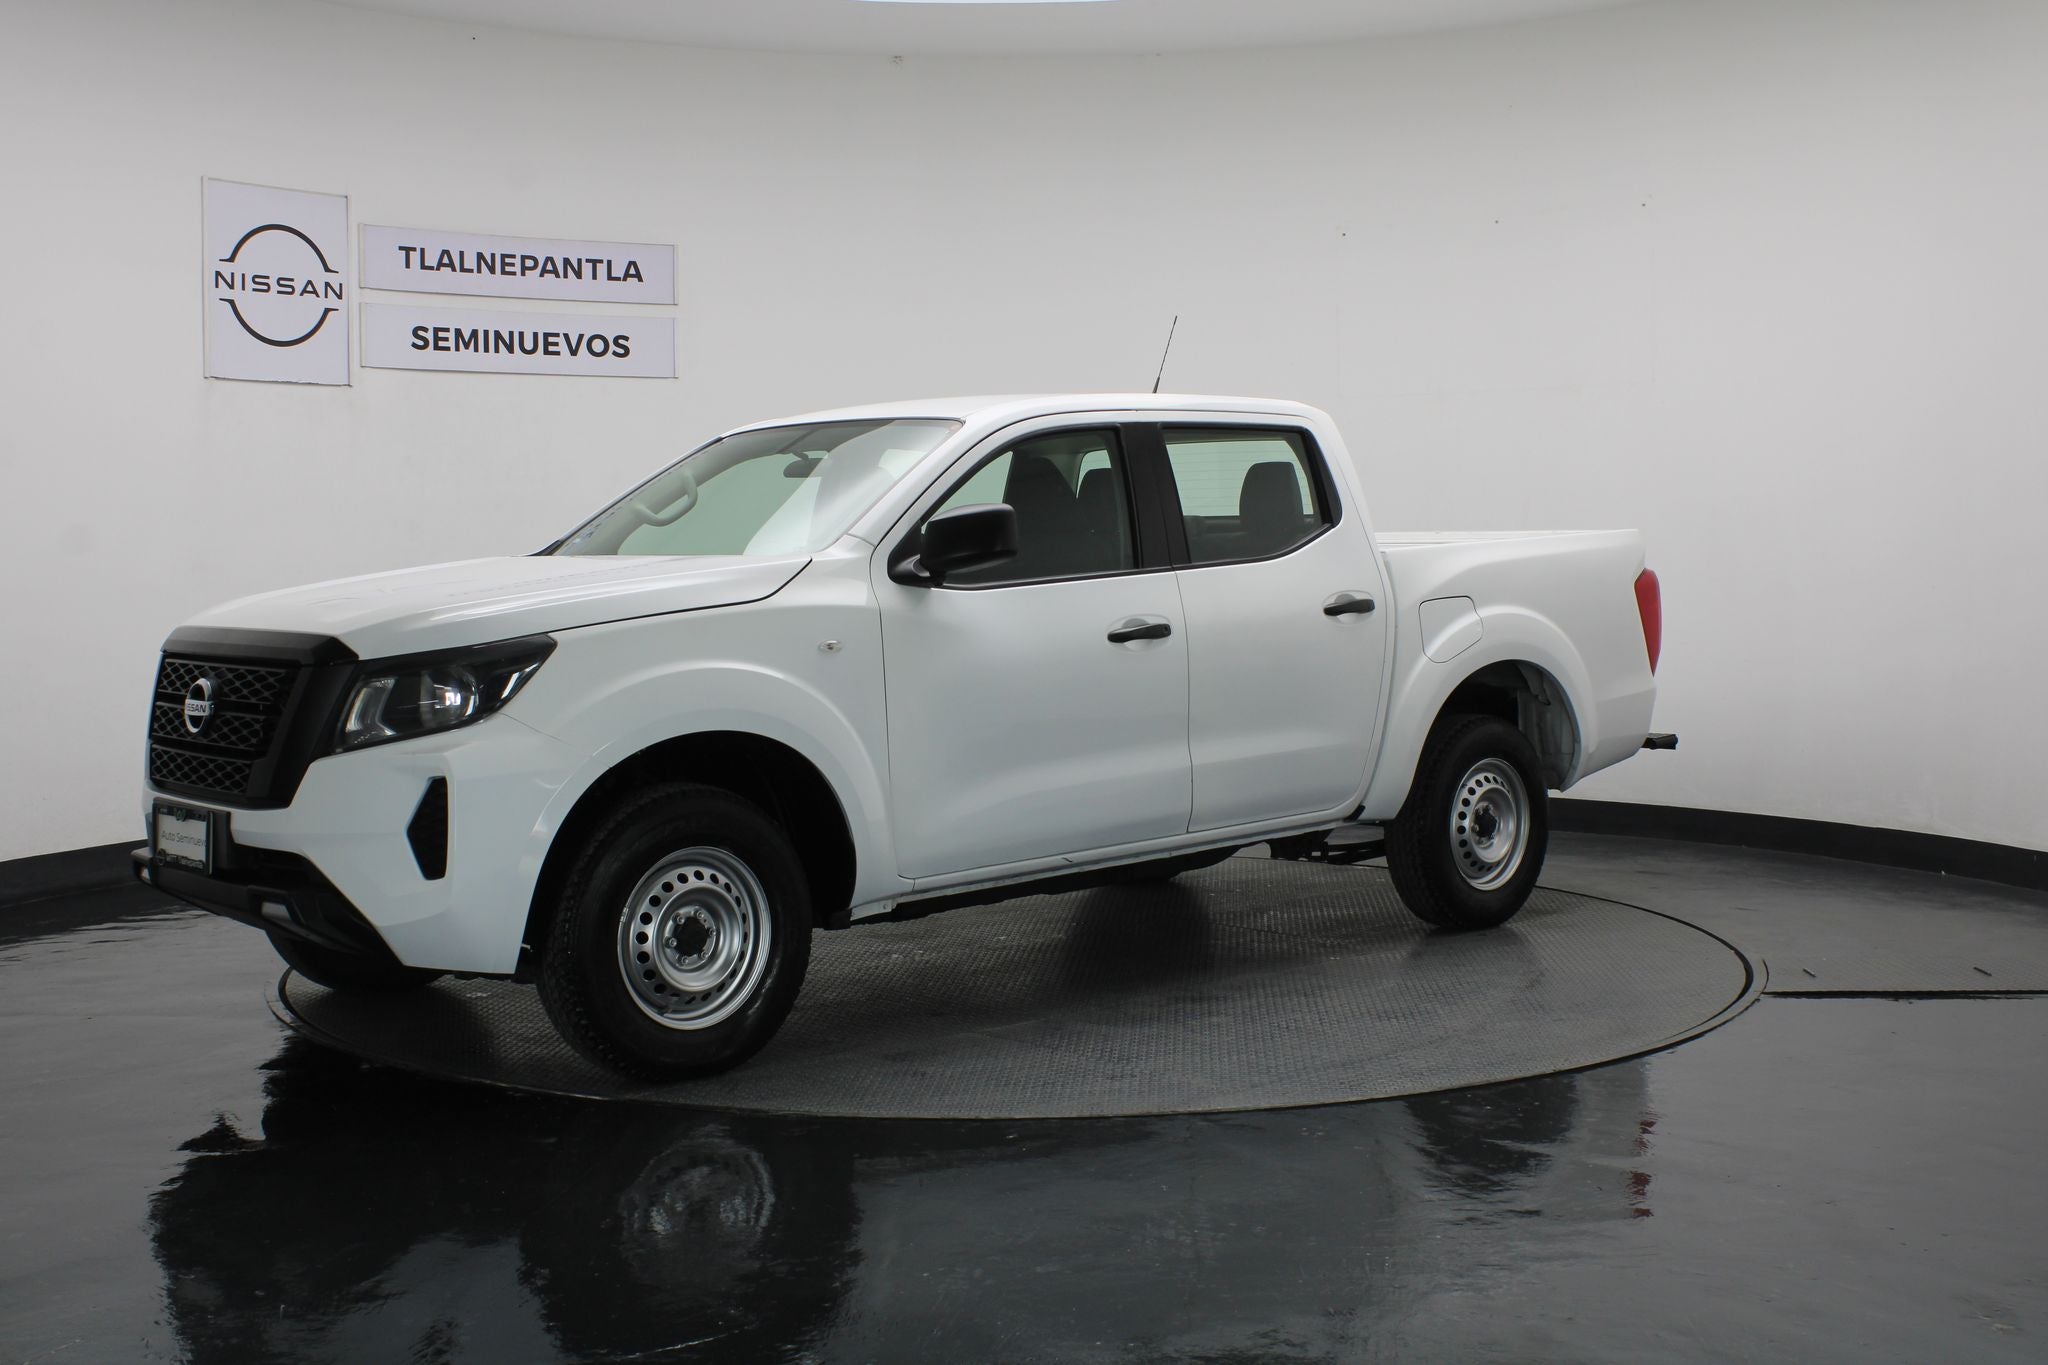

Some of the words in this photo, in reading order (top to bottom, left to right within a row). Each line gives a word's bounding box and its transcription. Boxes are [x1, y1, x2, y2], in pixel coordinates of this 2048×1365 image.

[398, 245, 644, 283] TLALNEPANTLA
[214, 270, 343, 301] NISSAN
[410, 325, 631, 359] SEMINUEVOS
